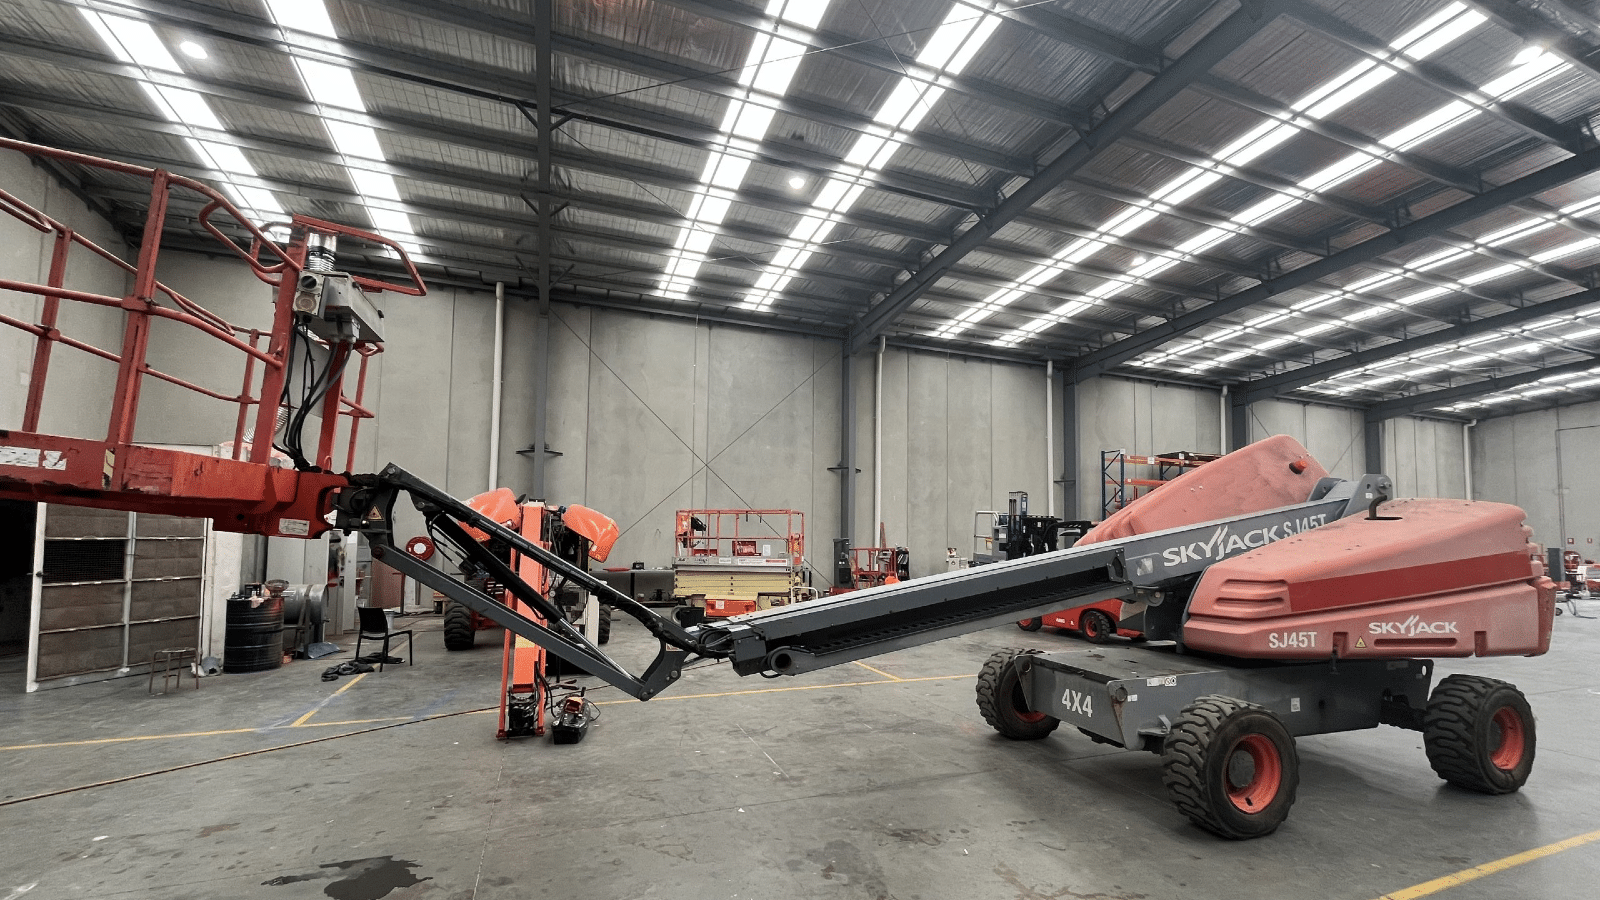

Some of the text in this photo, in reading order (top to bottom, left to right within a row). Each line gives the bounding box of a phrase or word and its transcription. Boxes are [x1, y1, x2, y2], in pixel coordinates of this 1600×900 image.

[1162, 525, 1280, 567] SKYJACK
[1368, 614, 1460, 637] SKYJACK
[1268, 631, 1318, 649] SJ45T
[1061, 688, 1093, 718] 4X4
